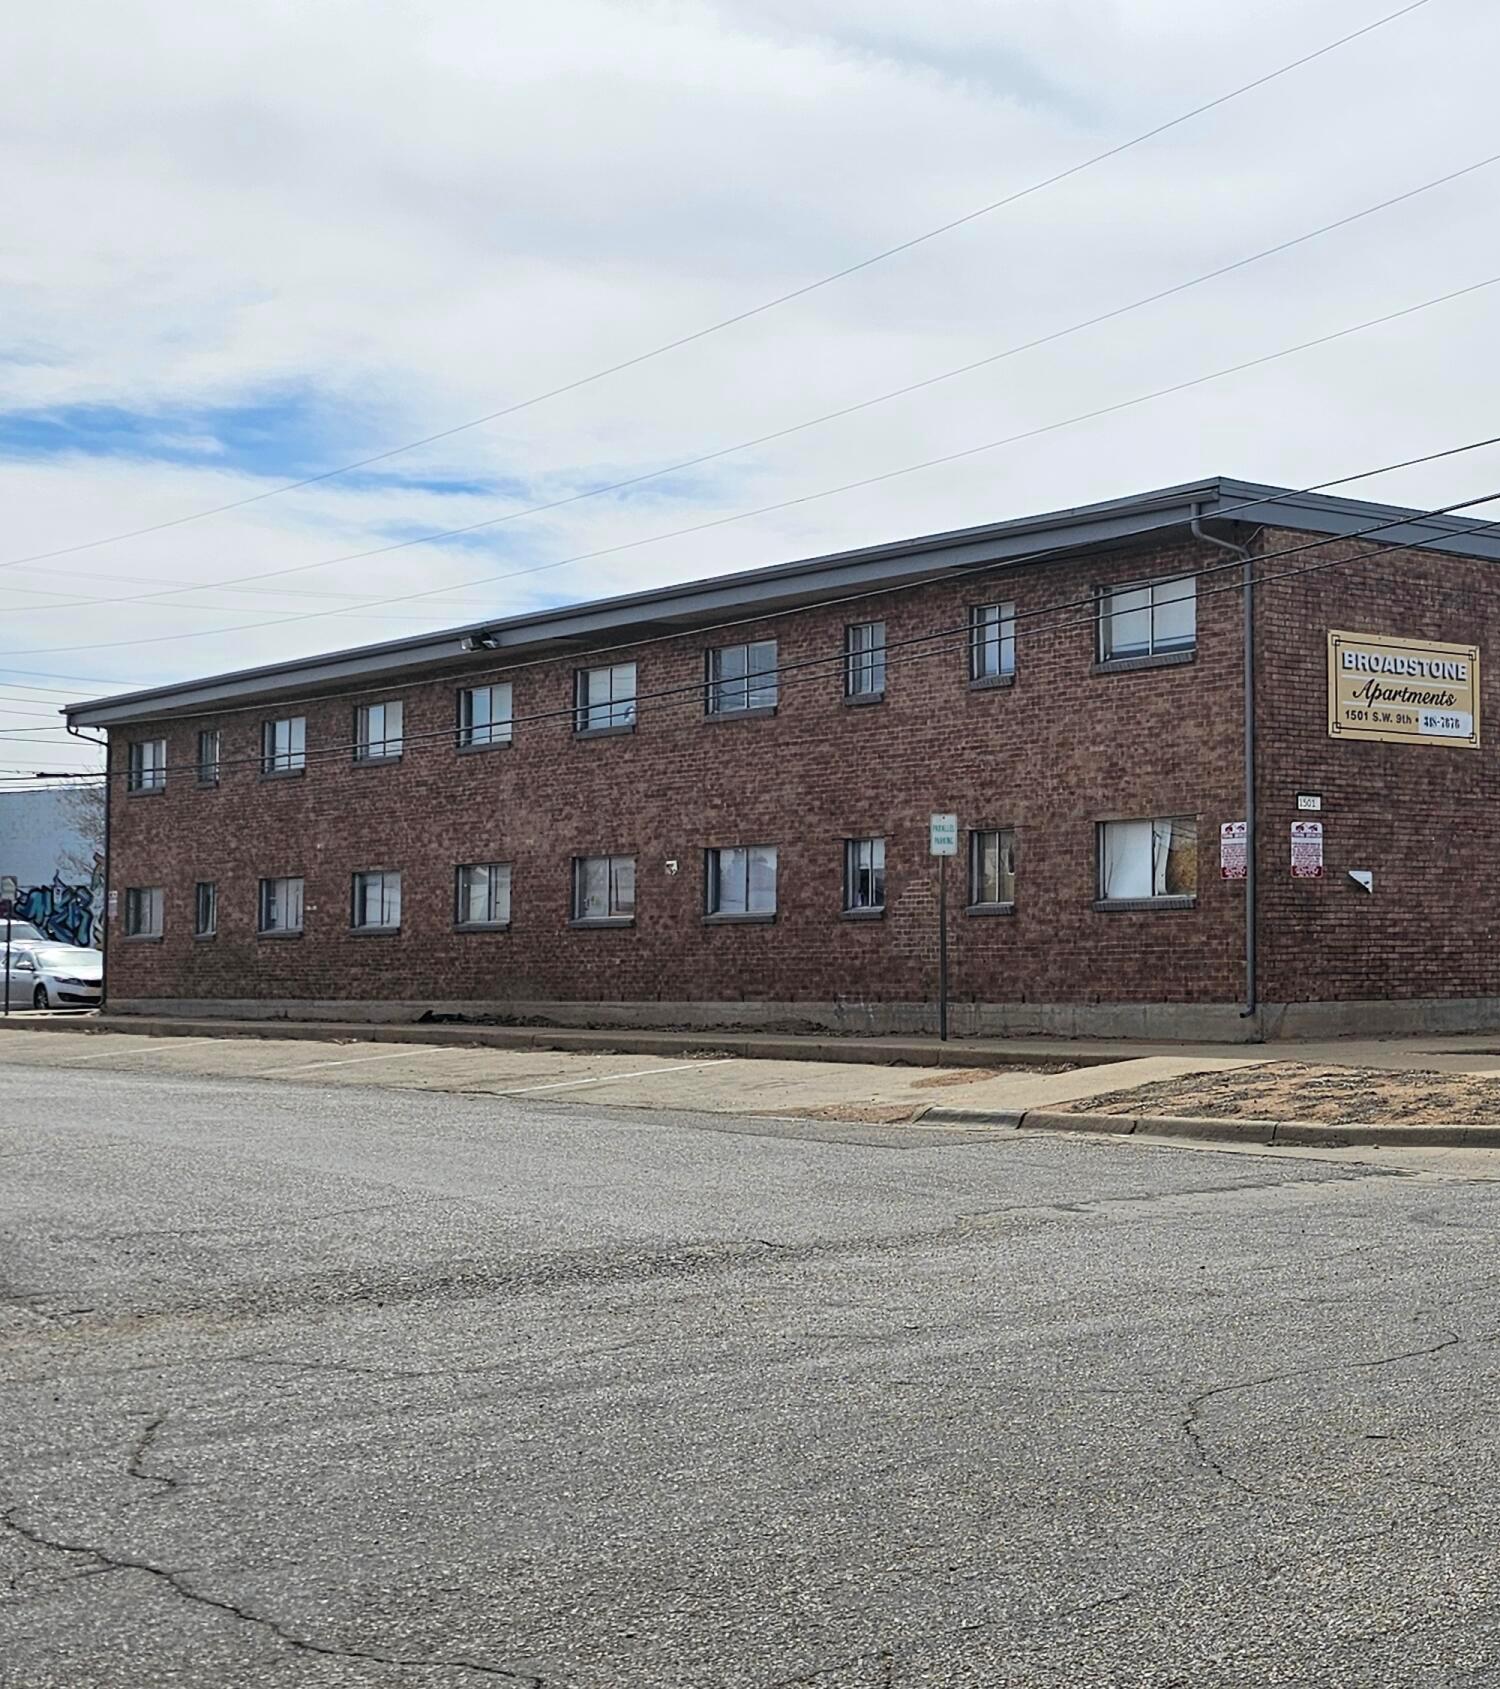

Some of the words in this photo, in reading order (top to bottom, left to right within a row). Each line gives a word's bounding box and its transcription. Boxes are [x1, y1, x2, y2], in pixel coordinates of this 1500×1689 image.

[1342, 651, 1467, 681] BROADSTONE
[1353, 679, 1457, 708] Apartments
[1345, 709, 1369, 721] 1501
[1372, 712, 1393, 724] S.W.
[1396, 714, 1412, 725] 9th
[1299, 798, 1316, 808] 1501
